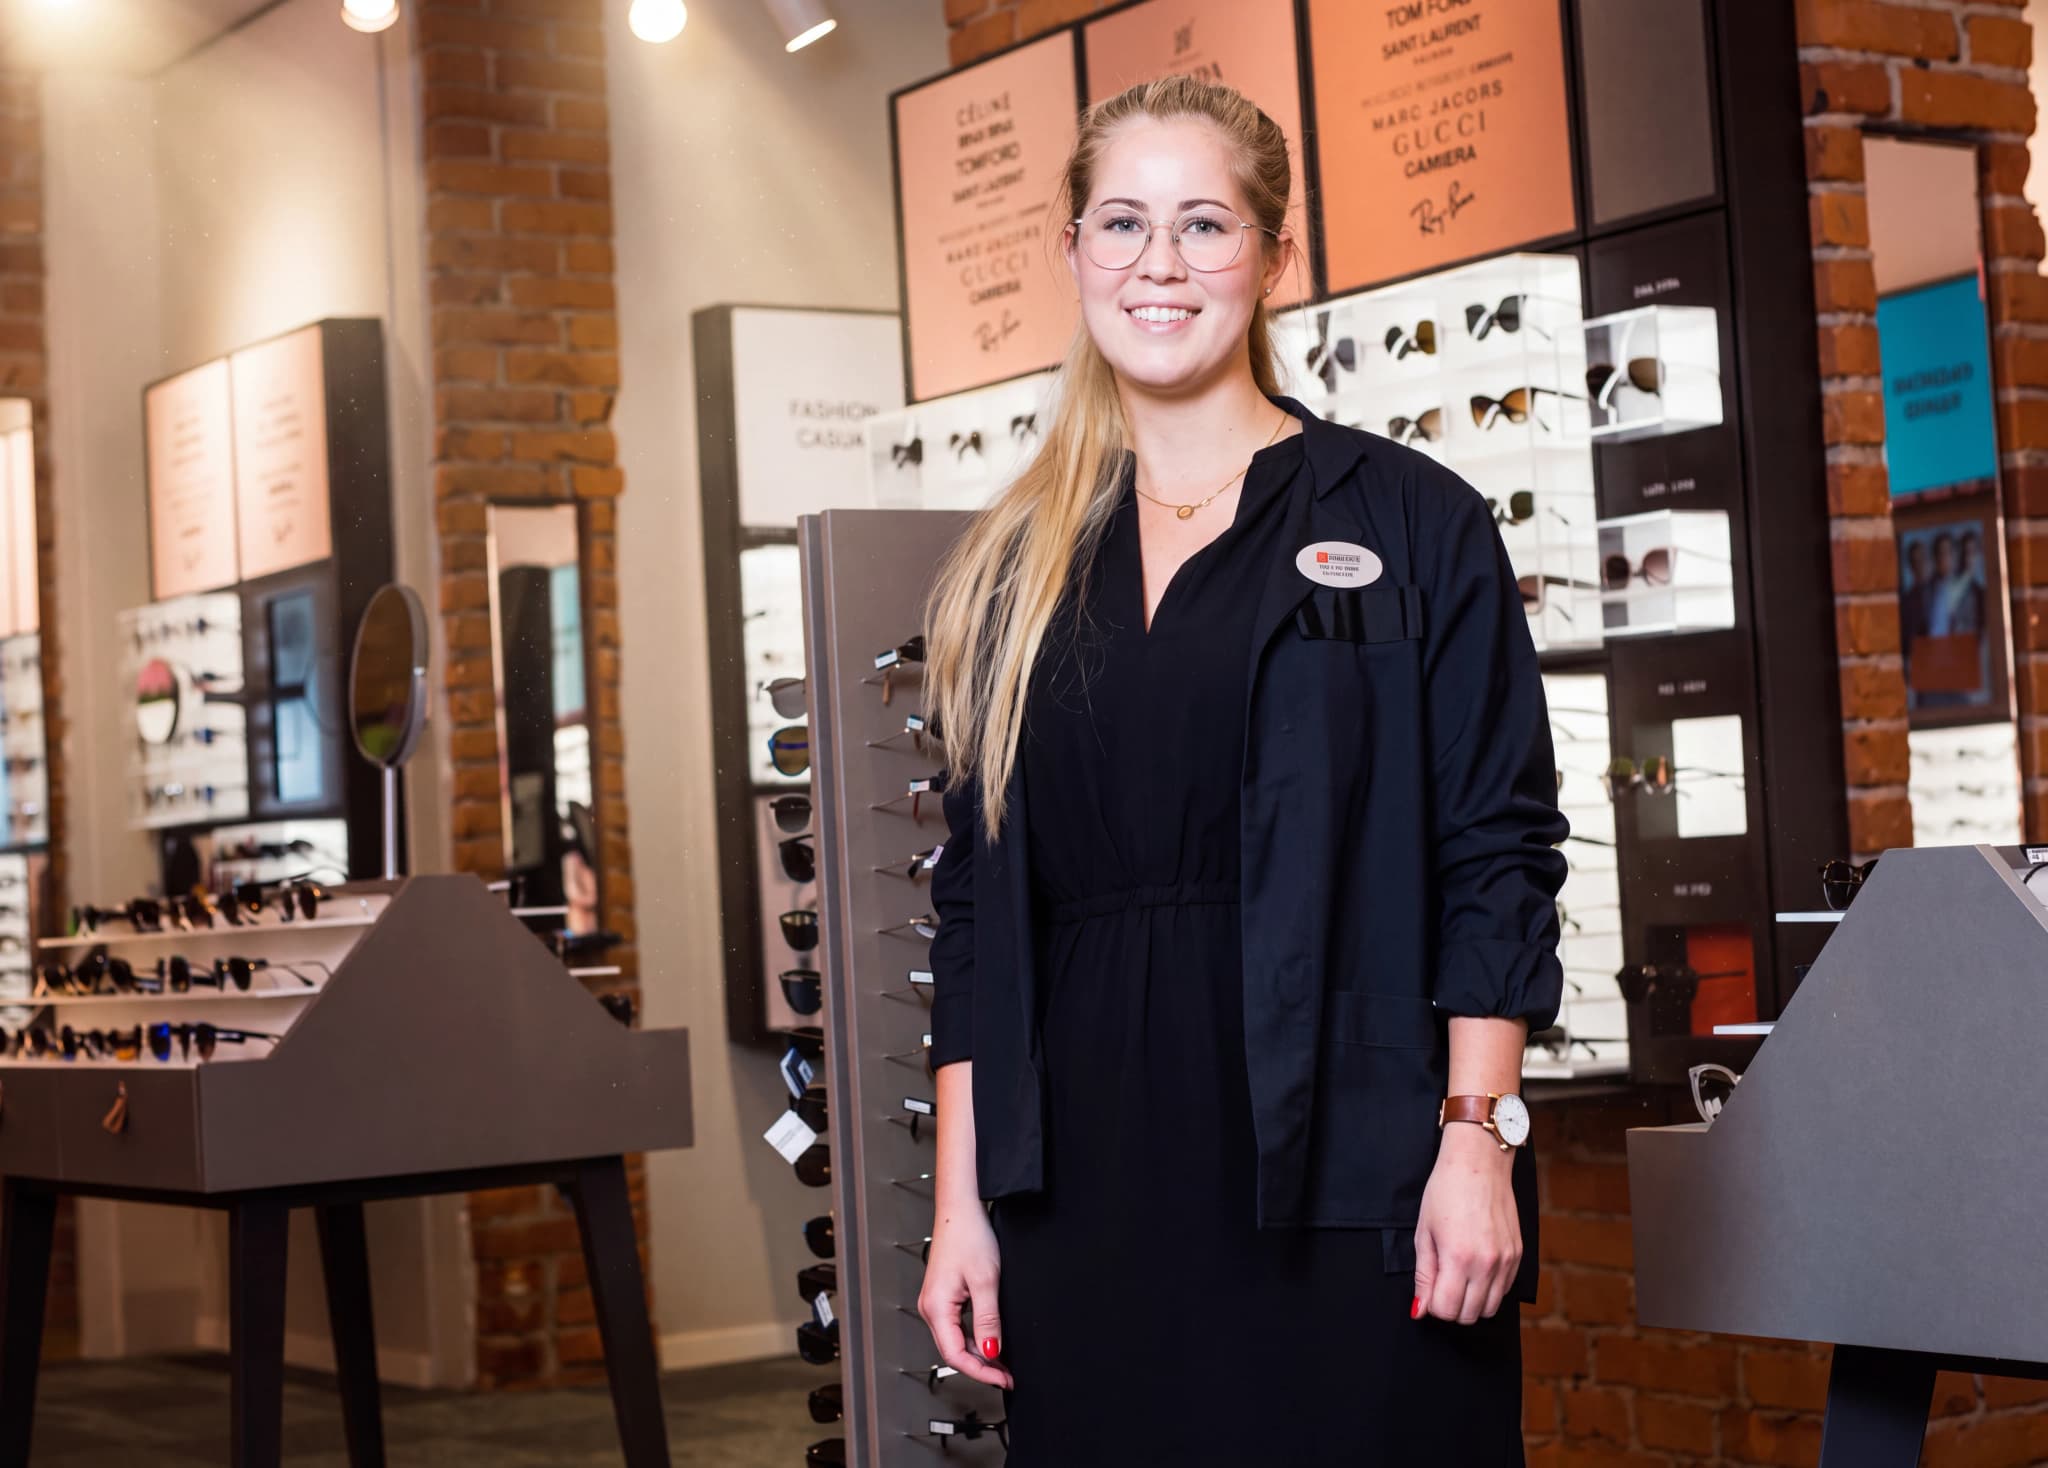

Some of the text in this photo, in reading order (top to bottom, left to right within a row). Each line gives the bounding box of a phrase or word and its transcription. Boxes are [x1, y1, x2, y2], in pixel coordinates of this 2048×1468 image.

[1386, 1, 1423, 29] TOM
[1382, 35, 1417, 61] SAINT
[1420, 13, 1481, 47] LAURENT
[1372, 104, 1421, 131] MARC
[1393, 109, 1486, 156] GUCCI
[797, 429, 865, 448] CASUA
